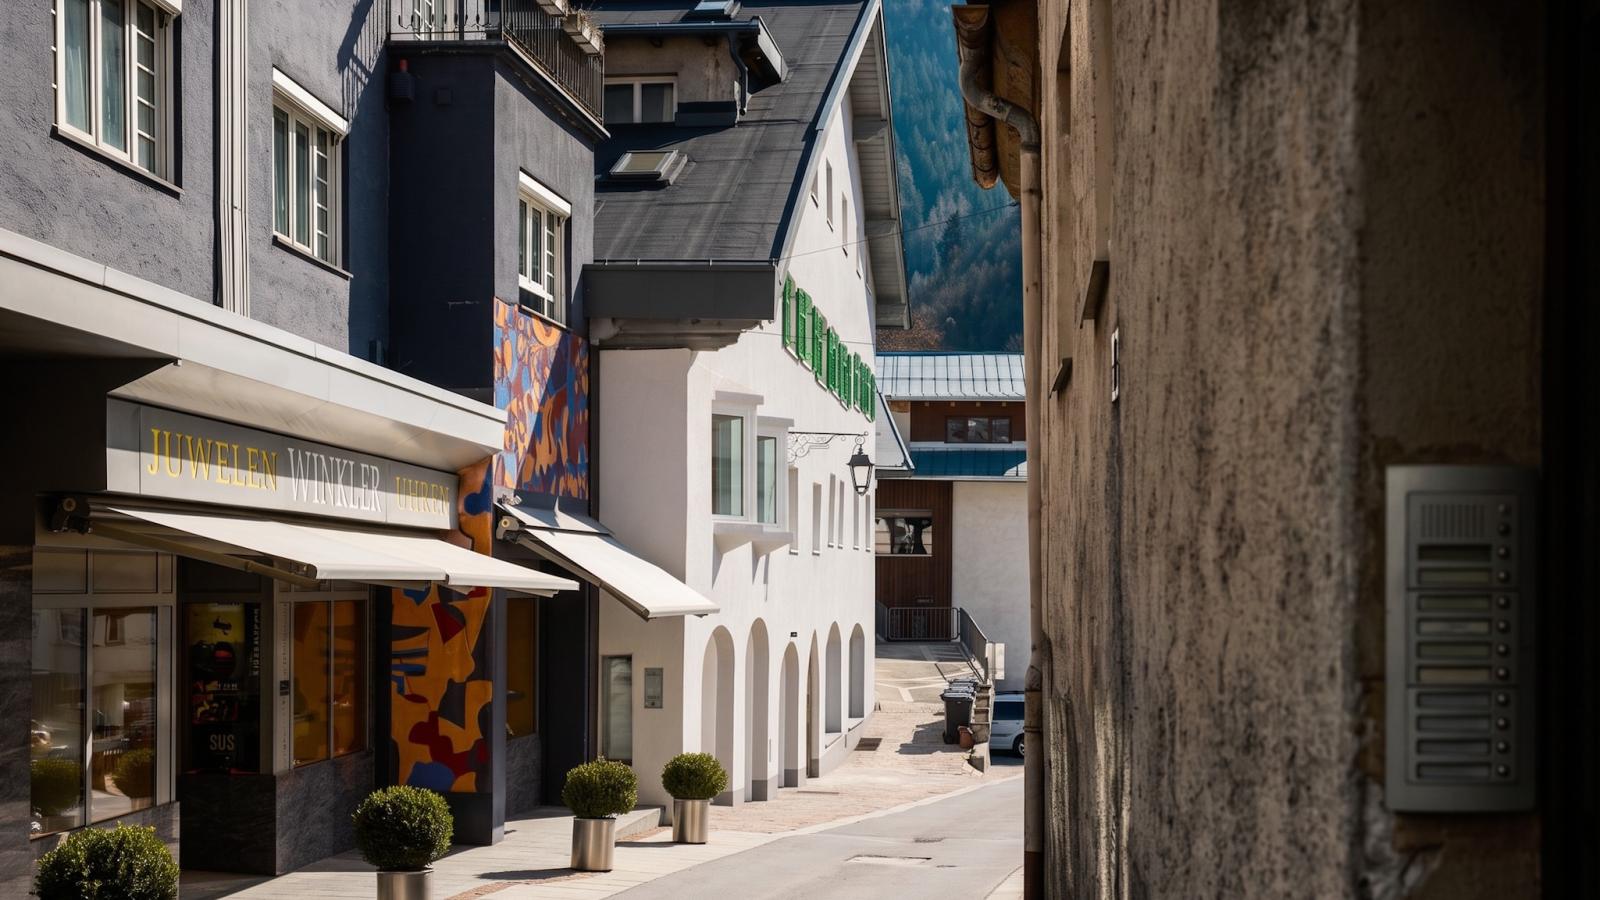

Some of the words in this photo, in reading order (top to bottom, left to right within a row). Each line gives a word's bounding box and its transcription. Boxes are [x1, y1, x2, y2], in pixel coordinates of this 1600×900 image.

[147, 428, 279, 492] JUWELEN
[287, 447, 382, 512] WINKLER
[395, 476, 450, 516] UHREN
[209, 734, 235, 751] SUS
